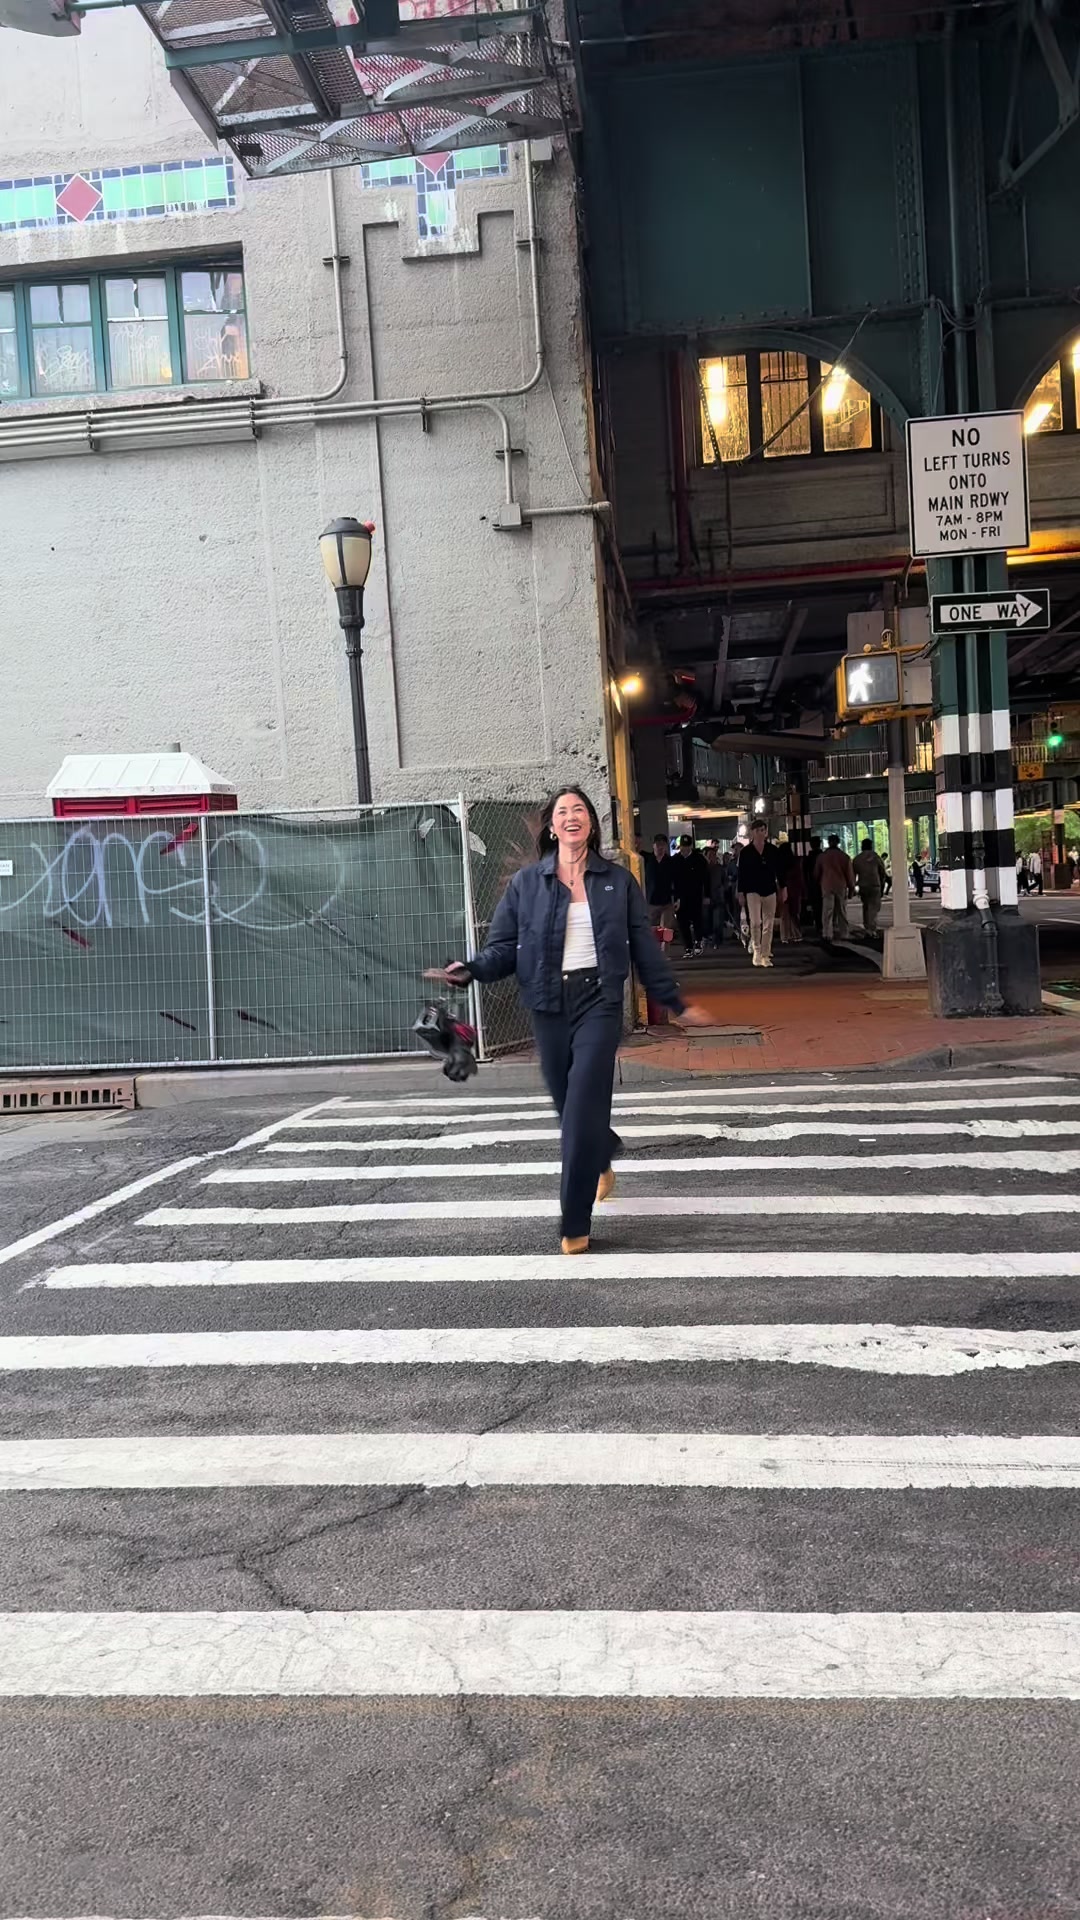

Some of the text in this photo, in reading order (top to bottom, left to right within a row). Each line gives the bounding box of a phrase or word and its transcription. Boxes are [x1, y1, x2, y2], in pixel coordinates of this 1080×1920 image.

[952, 428, 980, 447] NO
[924, 451, 1011, 472] LEFT TURNS
[949, 473, 987, 490] ONTO
[928, 491, 1009, 512] MAIN RDWY
[935, 514, 963, 526] 7AM
[976, 511, 1003, 523] 8PM
[939, 529, 967, 541] MON
[980, 526, 1001, 538] FRI
[949, 602, 1031, 621] ONE WAY
